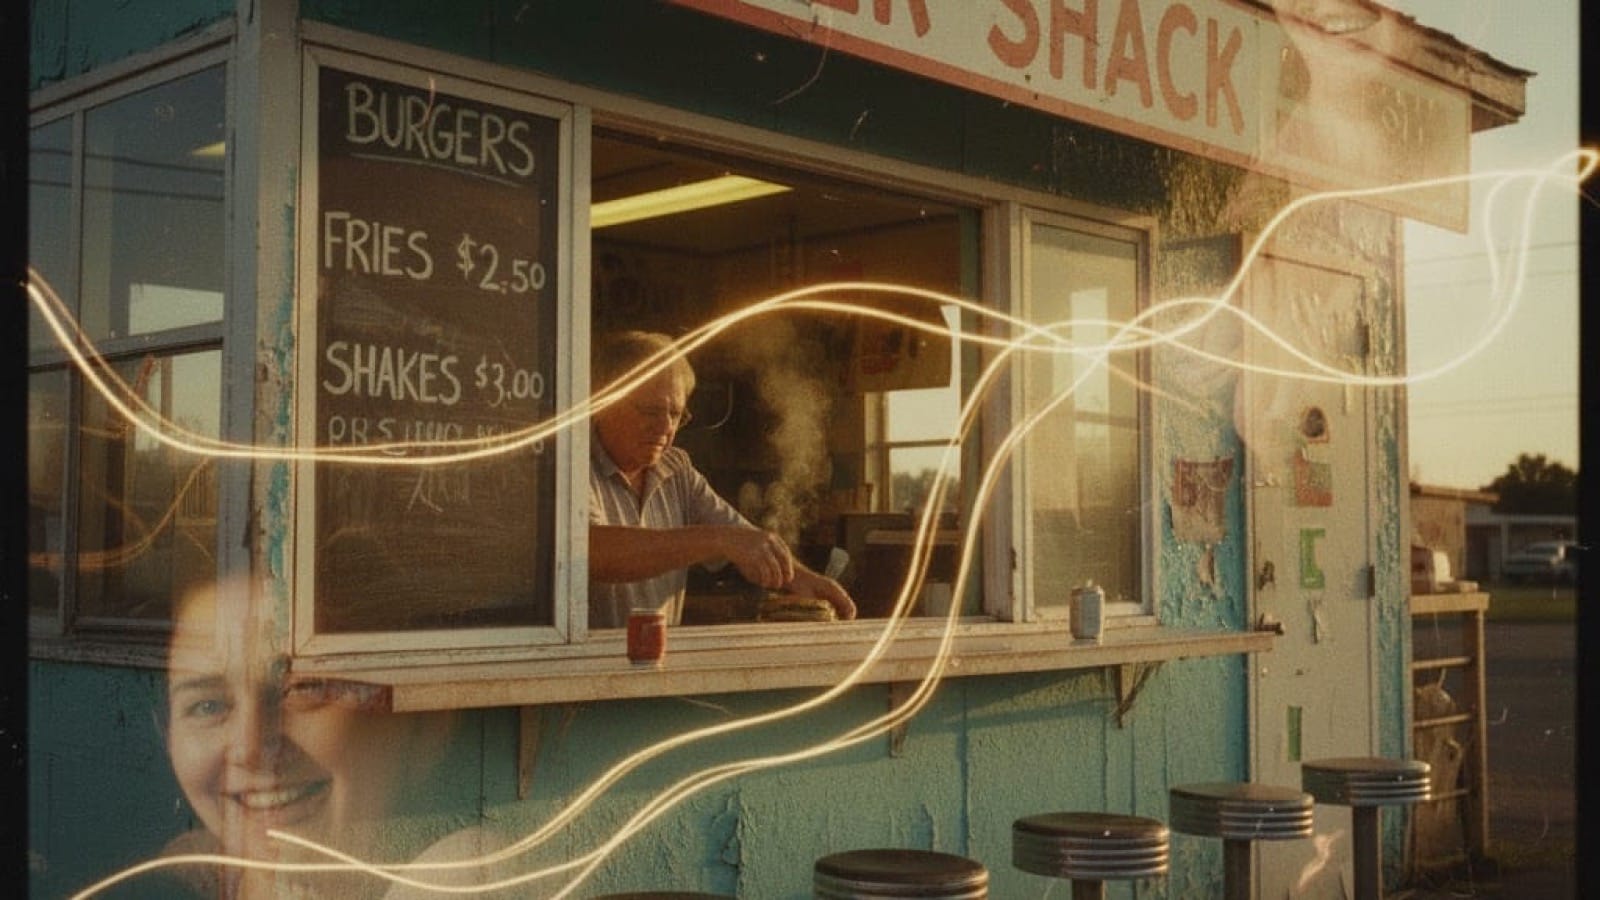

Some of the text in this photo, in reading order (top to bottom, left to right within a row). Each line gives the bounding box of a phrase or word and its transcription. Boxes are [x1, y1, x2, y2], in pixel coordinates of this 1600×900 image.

[987, 0, 1244, 136] SHACK
[346, 82, 535, 176] BURGERS
[324, 211, 546, 293] FRIES $2.50
[323, 341, 544, 408] SHAKES $3.00
